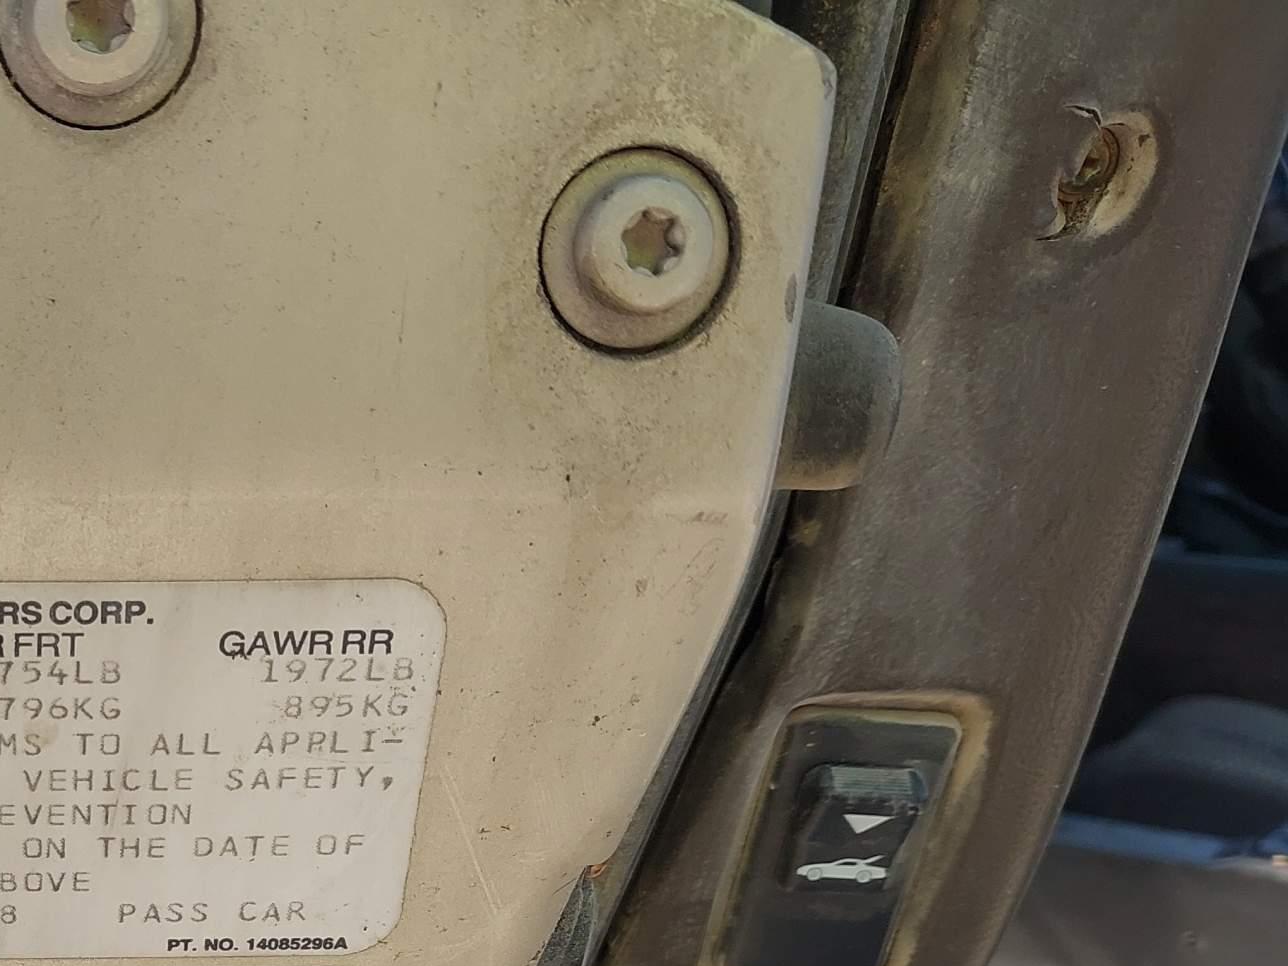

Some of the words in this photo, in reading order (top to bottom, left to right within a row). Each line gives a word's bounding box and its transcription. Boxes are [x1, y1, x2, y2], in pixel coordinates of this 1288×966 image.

[49, 600, 154, 626] CORP.
[14, 633, 85, 658] FRT
[220, 630, 333, 657] GAWR
[342, 630, 394, 655] RR
[262, 658, 414, 684] 1972LB
[284, 694, 409, 718] 895KG
[78, 732, 121, 756] TO
[151, 732, 221, 756] ALL
[255, 731, 403, 756] APPLI-
[23, 768, 193, 792] VEHICLE
[224, 766, 394, 791] SAFETY,
[22, 837, 67, 860] ON
[98, 836, 167, 859] THE
[193, 834, 290, 858] DATE
[315, 833, 367, 857] OF
[118, 902, 210, 924] PASS
[238, 900, 308, 923] CAR
[167, 938, 199, 952] PT.
[204, 938, 239, 952] NO.
[246, 937, 348, 952] 14085296A
